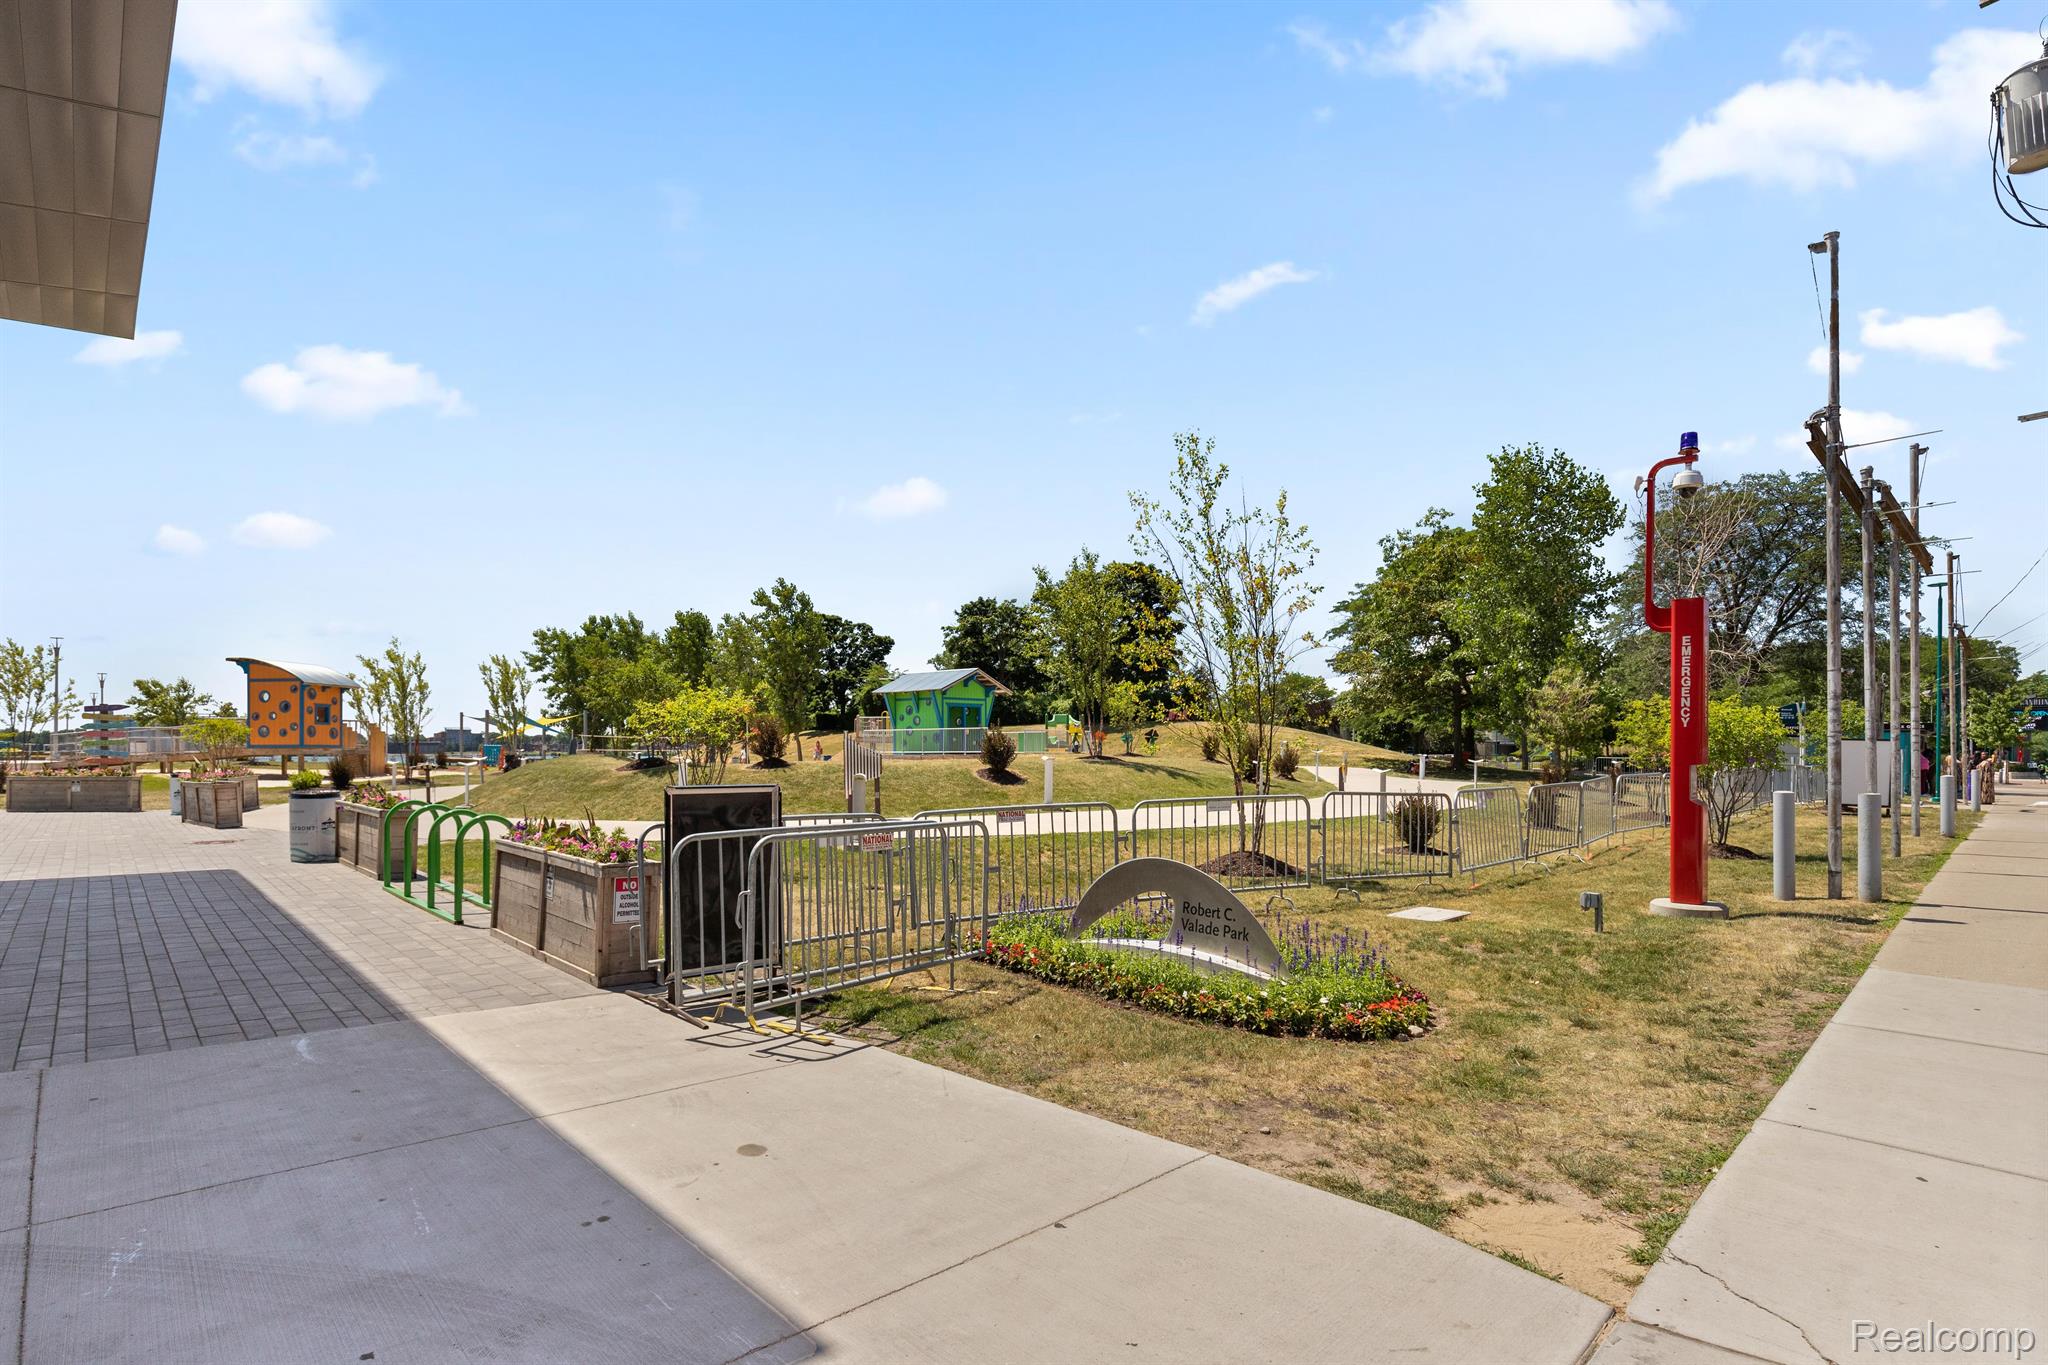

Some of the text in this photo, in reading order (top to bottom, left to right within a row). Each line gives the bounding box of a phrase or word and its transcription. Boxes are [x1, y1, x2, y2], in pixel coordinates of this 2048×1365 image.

[1680, 635, 1692, 728] EMERGENCY
[863, 835, 893, 845] NATIONAL
[622, 881, 637, 890] NO
[1182, 901, 1237, 922] Robert C.
[1181, 917, 1250, 943] Valade Park
